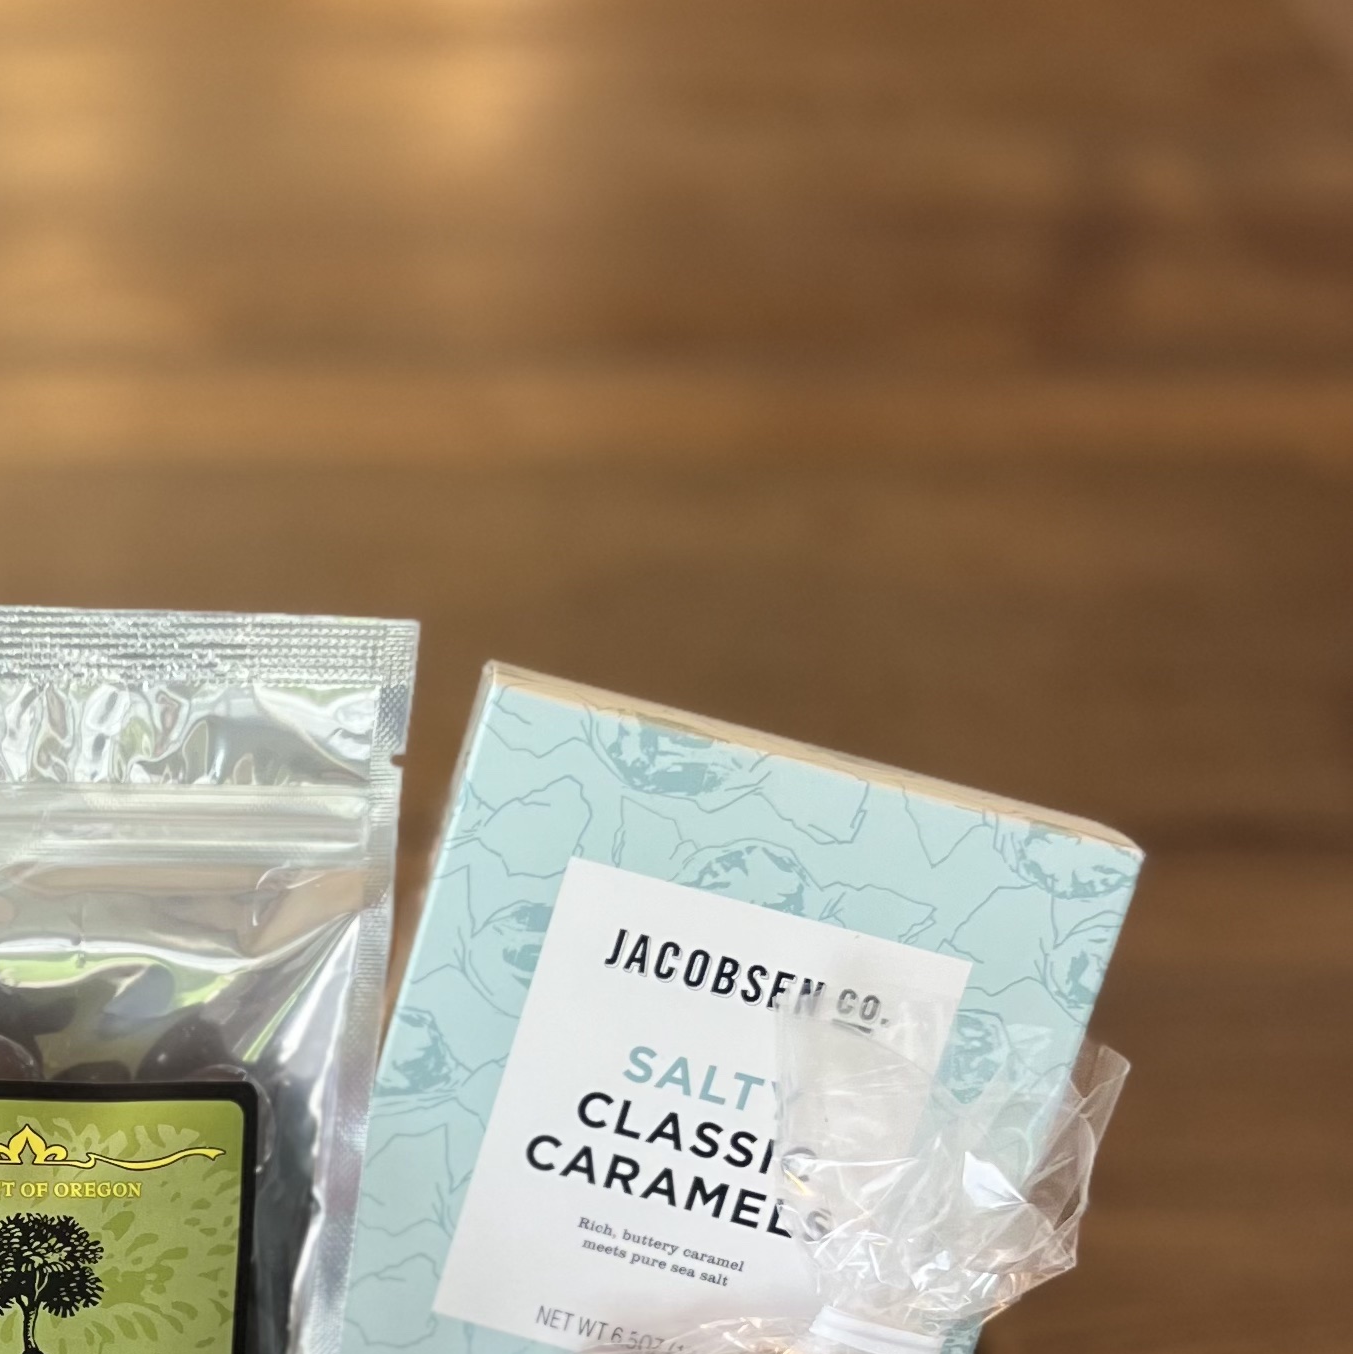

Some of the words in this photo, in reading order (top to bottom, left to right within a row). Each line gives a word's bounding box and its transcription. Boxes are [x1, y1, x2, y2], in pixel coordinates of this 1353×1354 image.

[603, 929, 826, 1016] JACOBSEN
[836, 988, 890, 1025] CO.
[21, 1182, 48, 1199] OF
[53, 1182, 142, 1199] OREGON
[577, 1217, 618, 1241] Rich,
[622, 1227, 680, 1256] buttery
[682, 1246, 745, 1273] caramel
[581, 1237, 627, 1259] meets
[629, 1252, 667, 1273] pure
[669, 1261, 697, 1277] sea
[699, 1267, 730, 1288] salt
[536, 1305, 577, 1336] NET
[578, 1317, 609, 1343] WT
